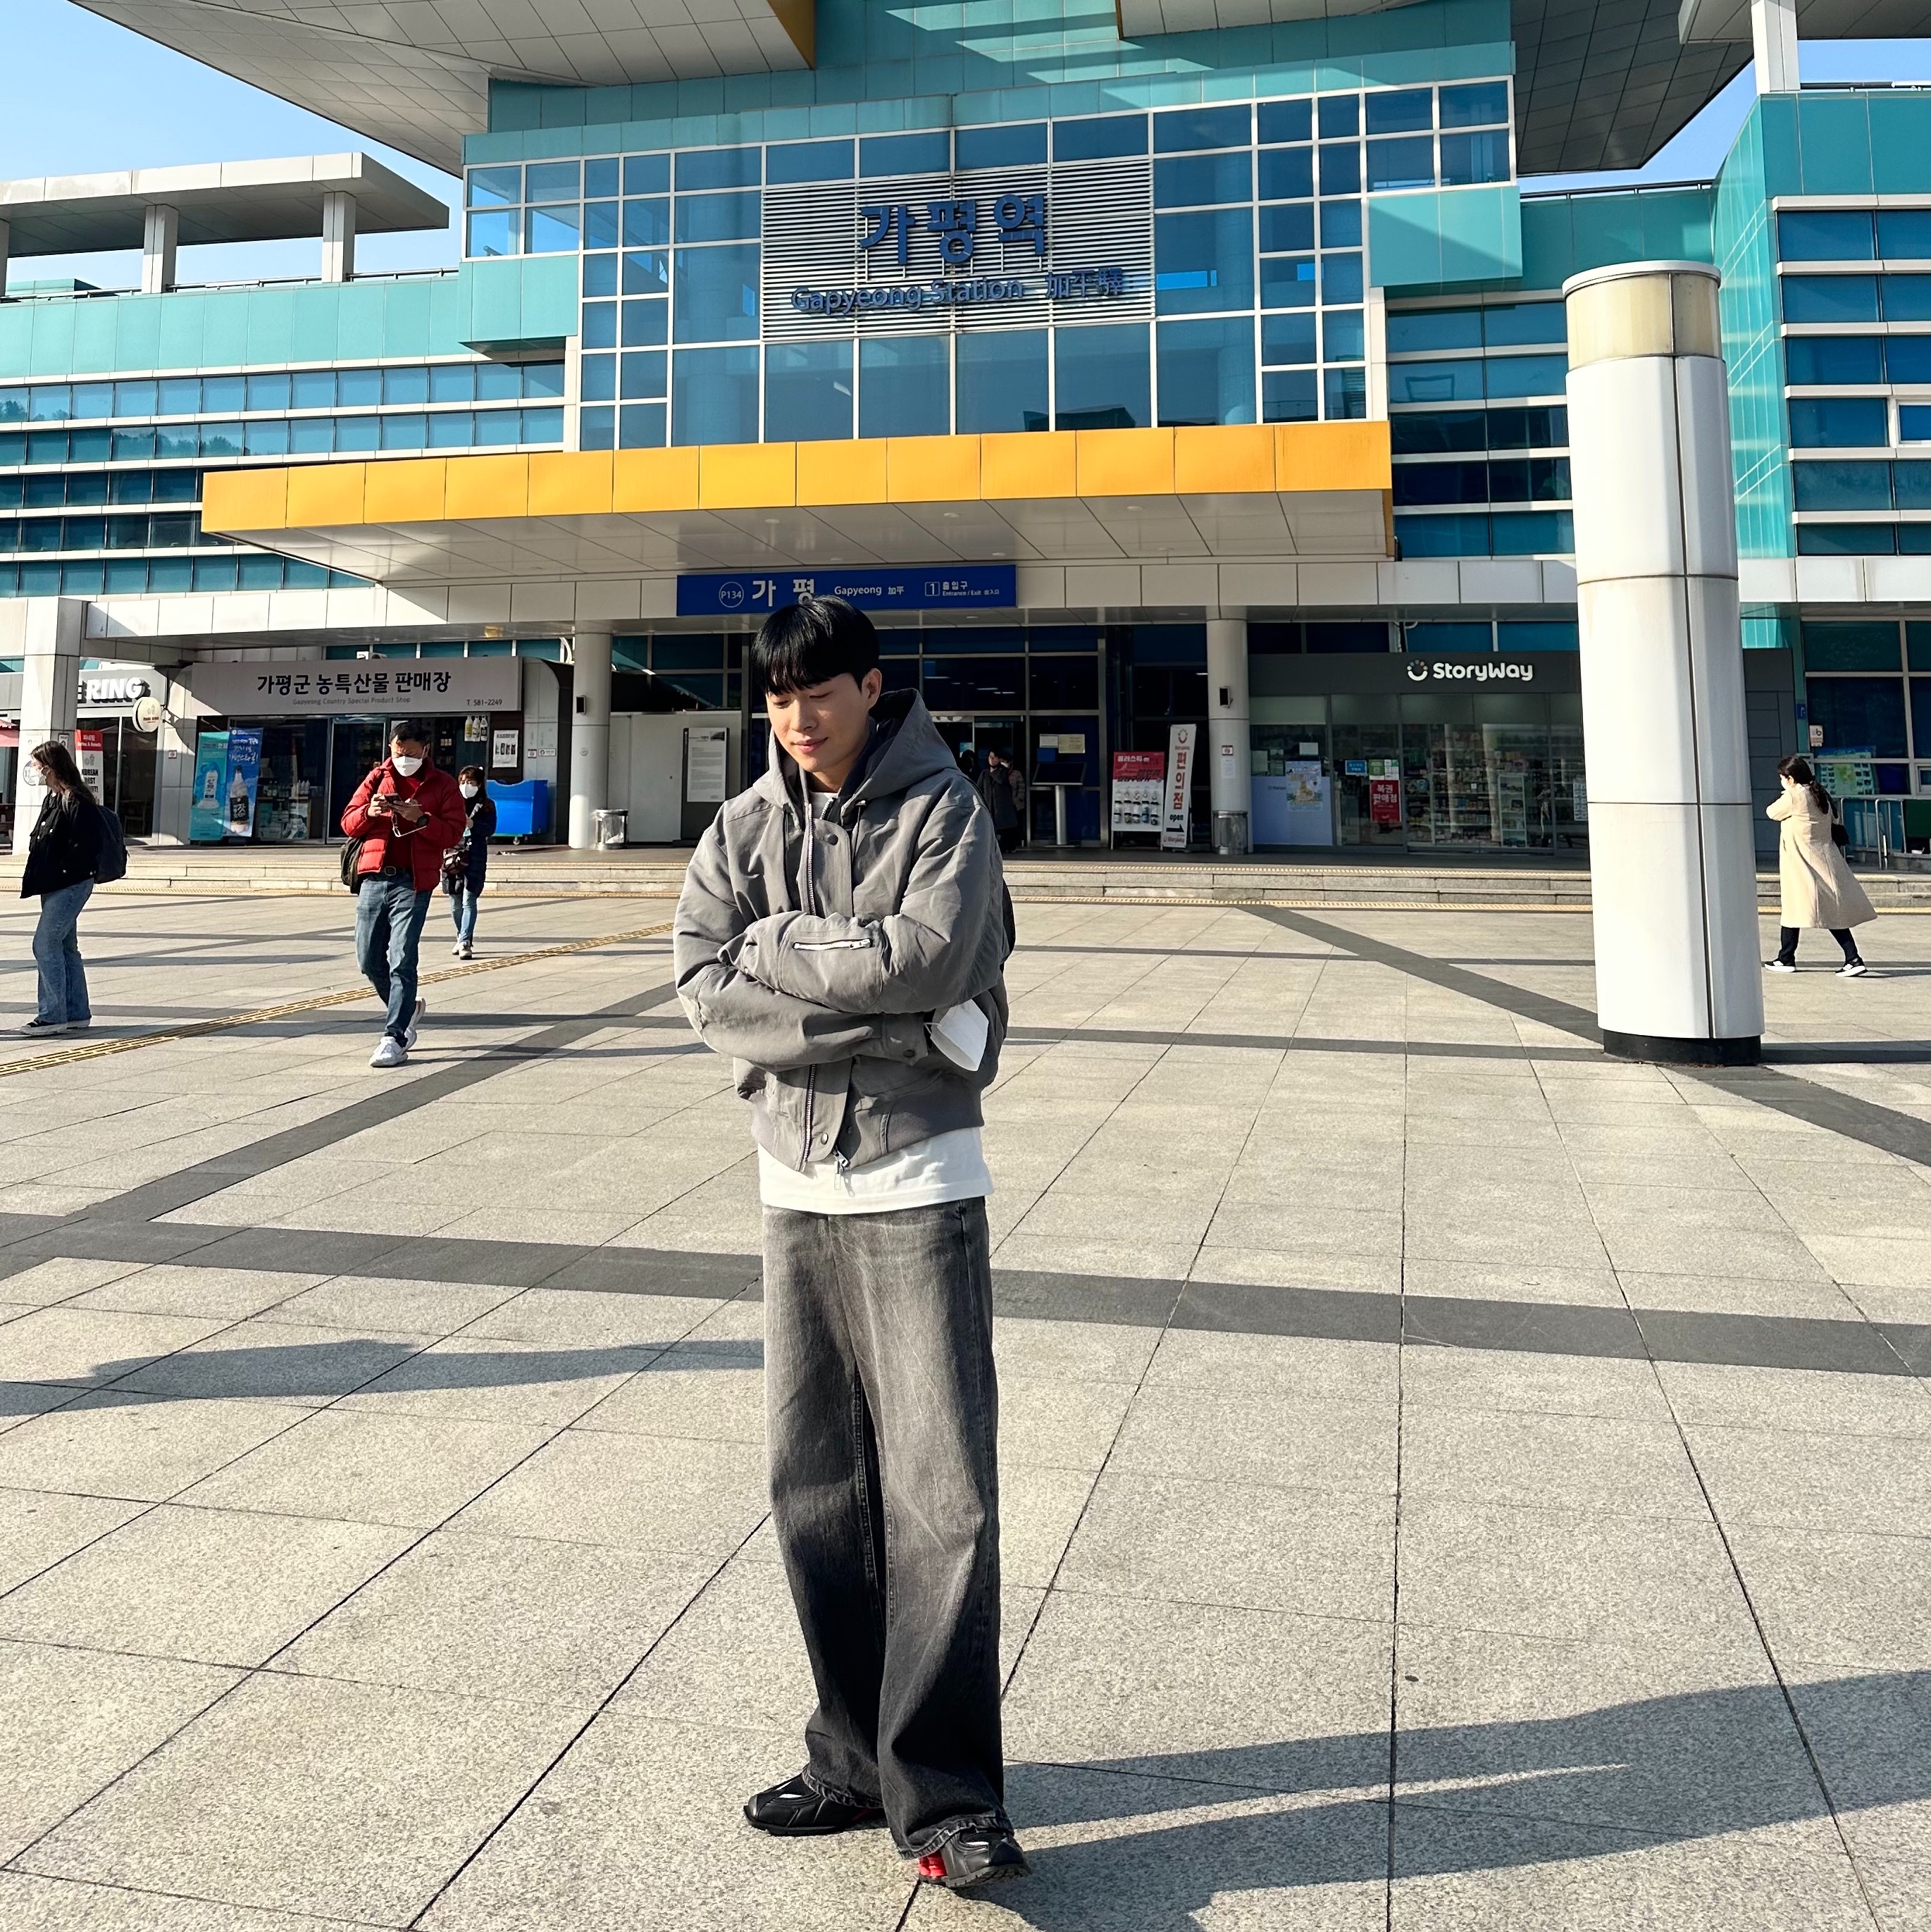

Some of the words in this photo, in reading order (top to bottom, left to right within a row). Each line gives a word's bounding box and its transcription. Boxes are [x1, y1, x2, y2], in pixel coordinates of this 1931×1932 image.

[859, 193, 1045, 266] 가평역
[791, 285, 923, 315] Gapyeong
[931, 277, 1024, 303] Station
[721, 590, 742, 600] P134
[834, 586, 882, 596] Gapyeong
[257, 674, 311, 696] 가평군
[316, 671, 390, 695] 농특산물
[395, 671, 452, 693] 판매장
[1173, 752, 1187, 810] 편의점
[1169, 814, 1184, 822] open
